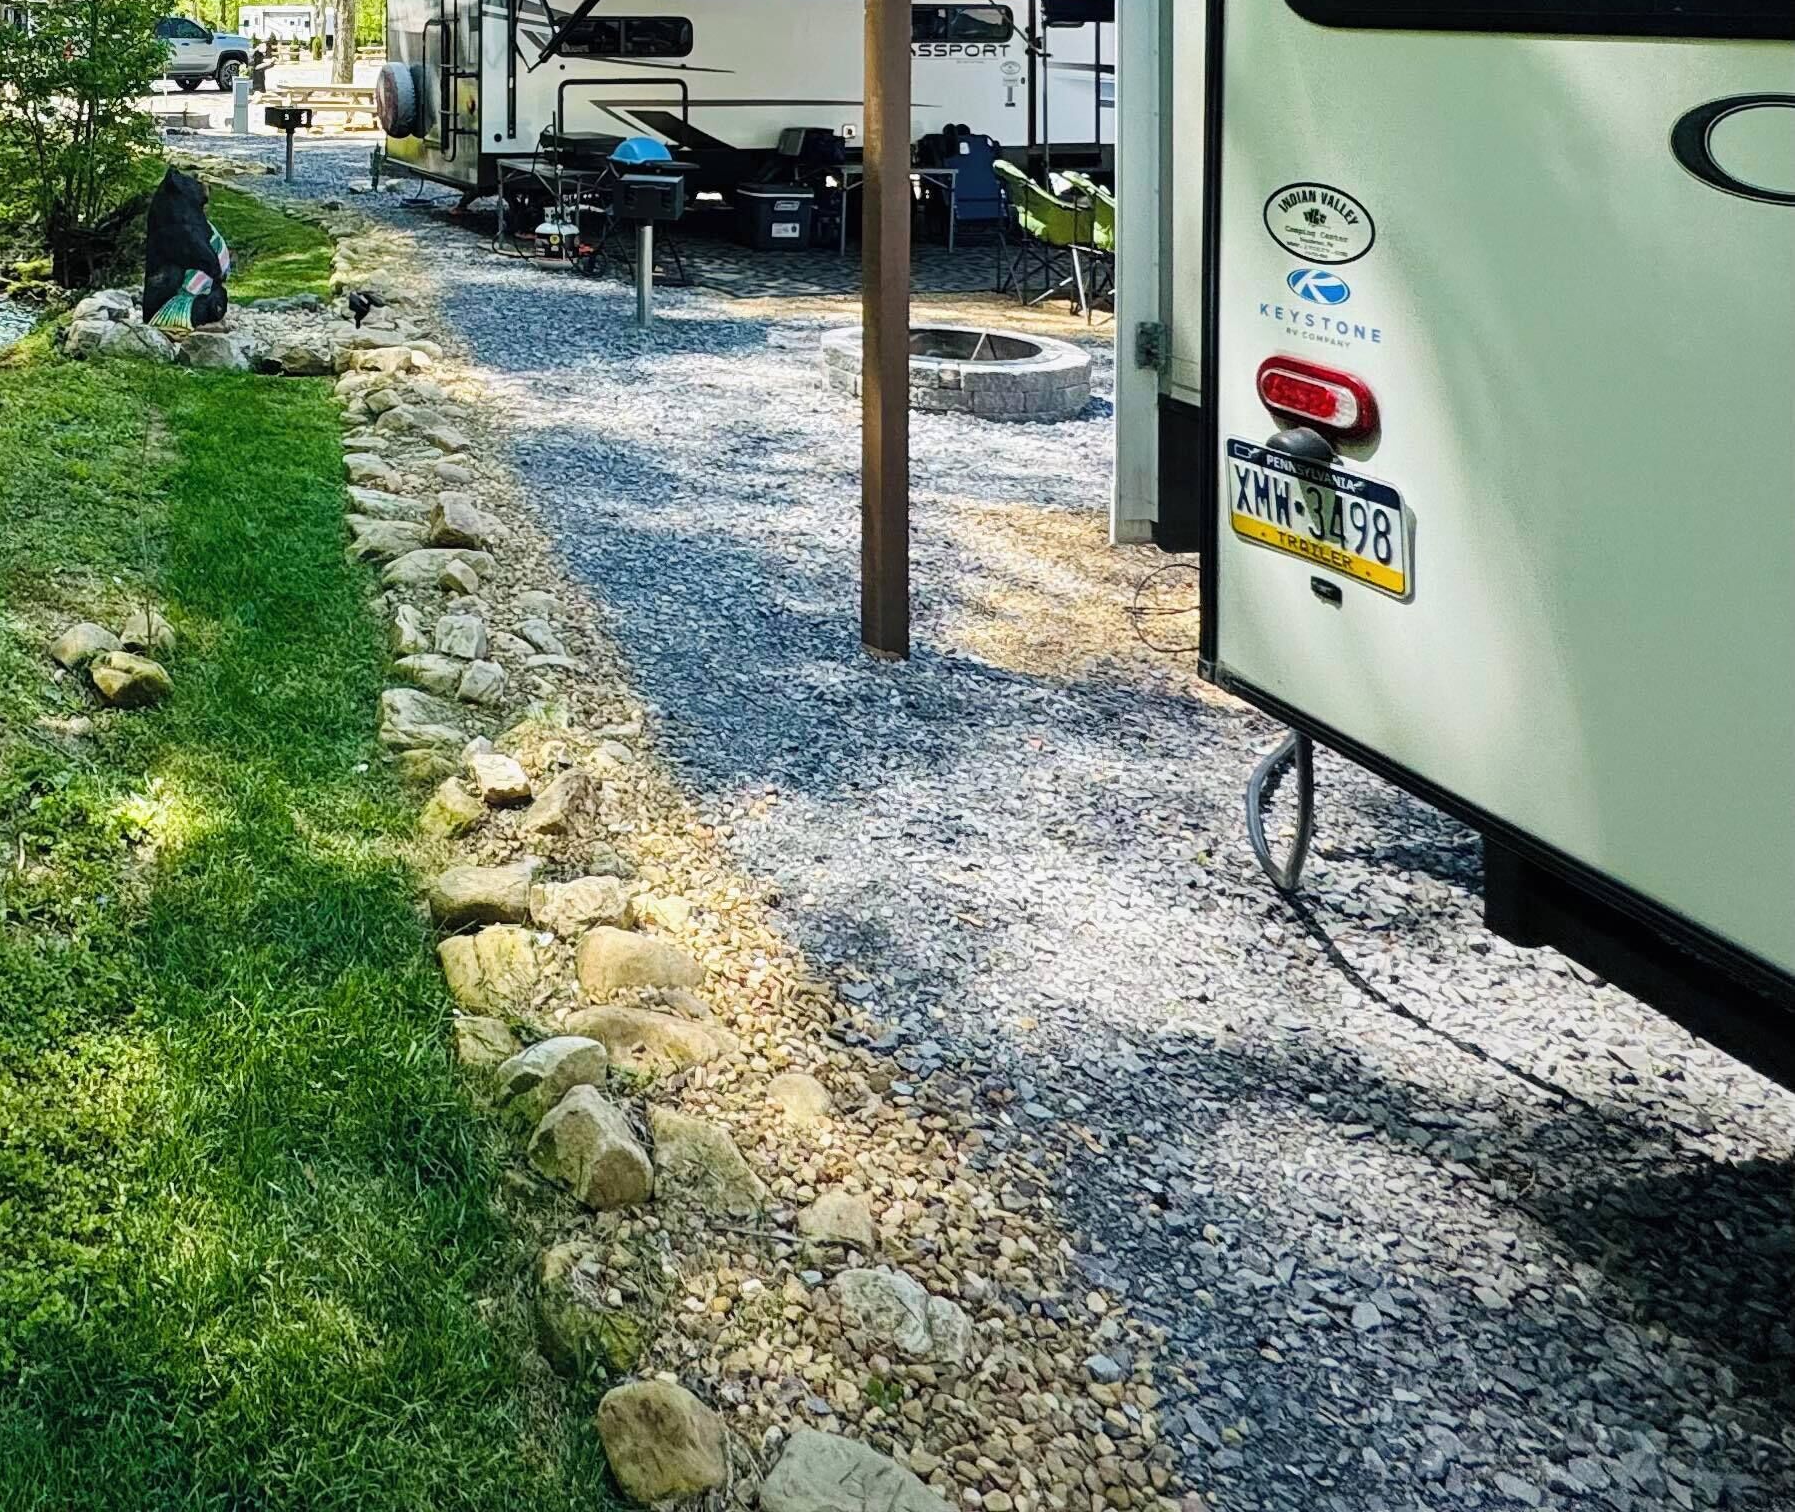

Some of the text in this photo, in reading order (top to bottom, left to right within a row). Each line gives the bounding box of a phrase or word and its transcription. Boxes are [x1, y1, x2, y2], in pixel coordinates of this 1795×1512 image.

[910, 44, 1010, 57] SSPORT
[1278, 190, 1316, 213] INDIAN
[1321, 192, 1359, 225] VALLEY
[1259, 303, 1381, 343] KEYSTONE
[1286, 327, 1351, 348] RV COMPANY
[1266, 454, 1355, 492] PENNSYLVANIA
[1277, 530, 1354, 571] TRAILER
